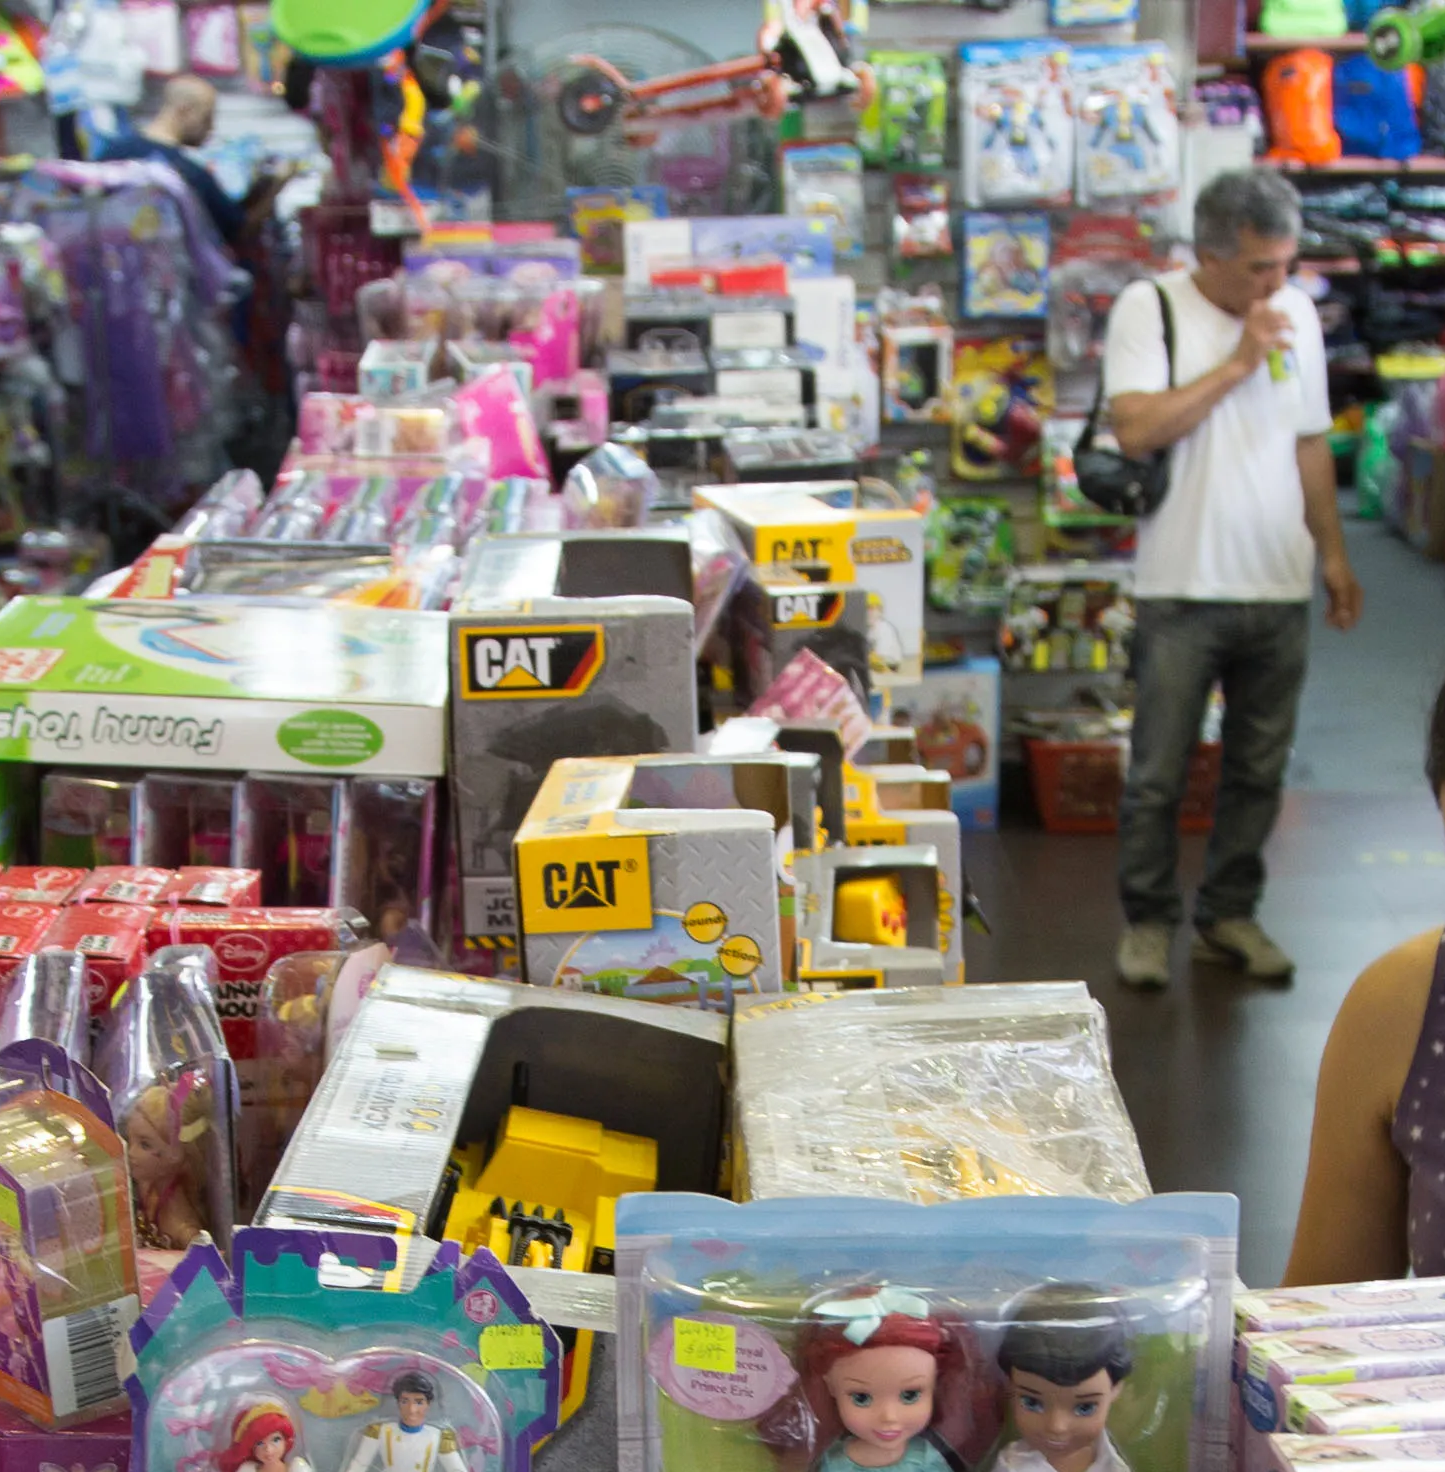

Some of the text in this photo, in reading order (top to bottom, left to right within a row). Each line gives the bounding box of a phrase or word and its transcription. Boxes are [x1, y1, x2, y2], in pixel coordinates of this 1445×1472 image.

[776, 596, 822, 623] CAT
[474, 636, 558, 687] CAT
[92, 705, 225, 755] Funny
[542, 861, 620, 910] CAT
